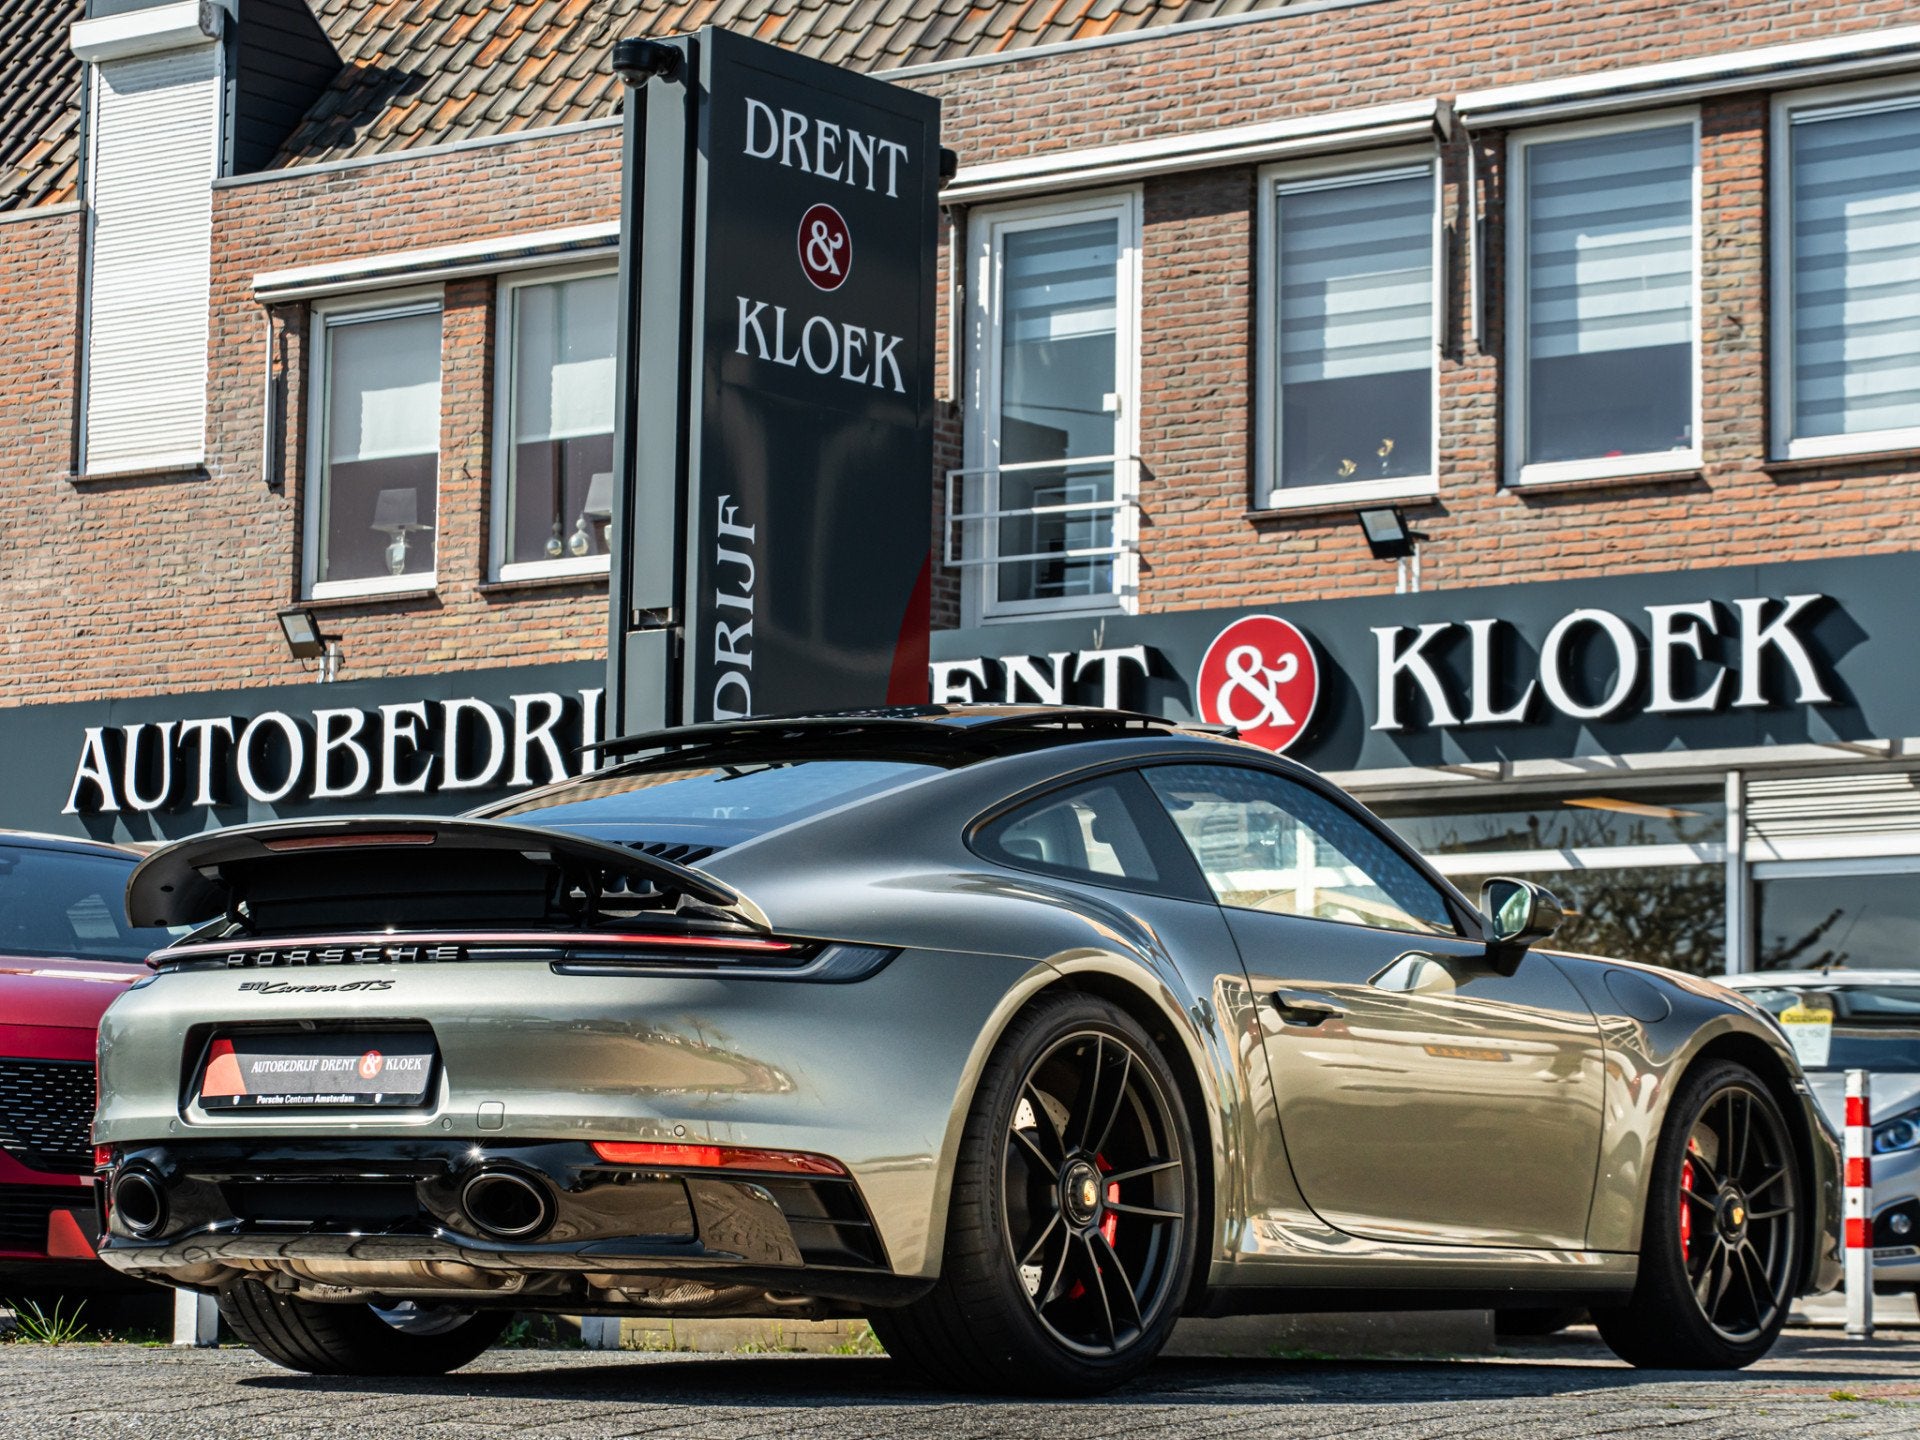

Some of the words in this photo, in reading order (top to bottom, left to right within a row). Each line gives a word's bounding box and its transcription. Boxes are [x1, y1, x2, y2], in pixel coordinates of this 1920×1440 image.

[743, 97, 909, 199] DRENT
[806, 219, 843, 277] &
[735, 295, 906, 394] KLOEK
[712, 494, 756, 721] DRIJF
[1216, 644, 1299, 731] &
[1370, 593, 1832, 731] KLOEK
[227, 946, 460, 969] PORSCHE
[337, 980, 396, 992] GTS
[250, 1058, 319, 1074] AUTOBEDRIJF
[319, 1057, 357, 1073] DRENT
[362, 1053, 383, 1075] &
[384, 1057, 423, 1071] KLOEK
[256, 1094, 284, 1105] Porsche
[284, 1094, 314, 1105] Centrum
[314, 1093, 356, 1104] Amsterdam
